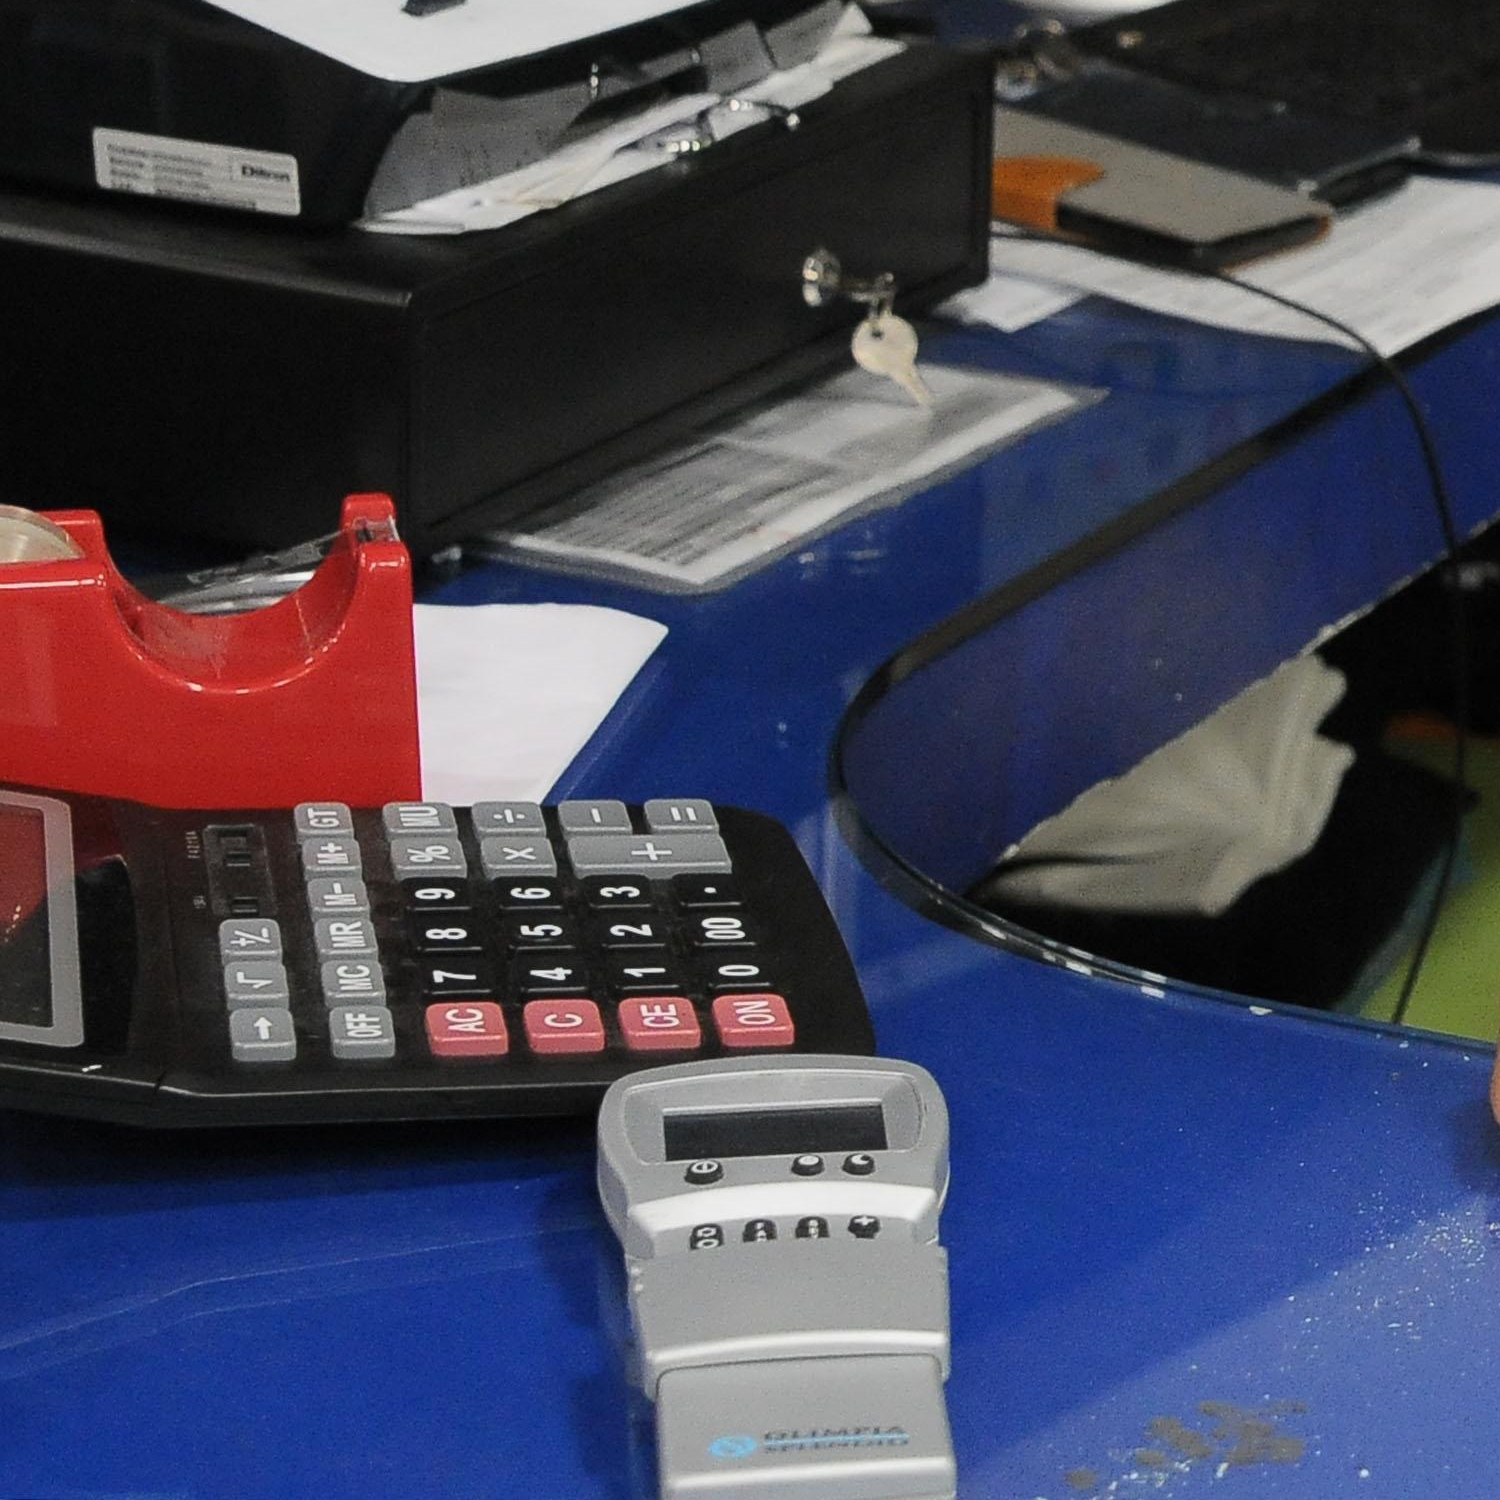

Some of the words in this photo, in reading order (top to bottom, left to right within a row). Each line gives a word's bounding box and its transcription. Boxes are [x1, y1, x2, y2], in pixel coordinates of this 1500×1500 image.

[308, 808, 340, 828] GT
[399, 806, 442, 827] MU
[317, 842, 349, 865] M+
[415, 888, 456, 900] 9
[510, 887, 551, 900] 6
[600, 886, 641, 898] 3
[329, 920, 366, 948] MR
[425, 928, 468, 941] 8
[519, 923, 563, 937] 5
[610, 923, 653, 937] 2
[701, 917, 746, 940] 00
[336, 965, 374, 991] MC
[432, 969, 477, 983] 7
[529, 967, 572, 981] 4
[623, 967, 666, 978] 1
[718, 964, 760, 977] 0
[445, 1008, 487, 1033] AC
[543, 1013, 583, 1028] C
[639, 1003, 680, 1028] CE
[733, 1000, 777, 1026] ON
[344, 1012, 383, 1038] OFF
